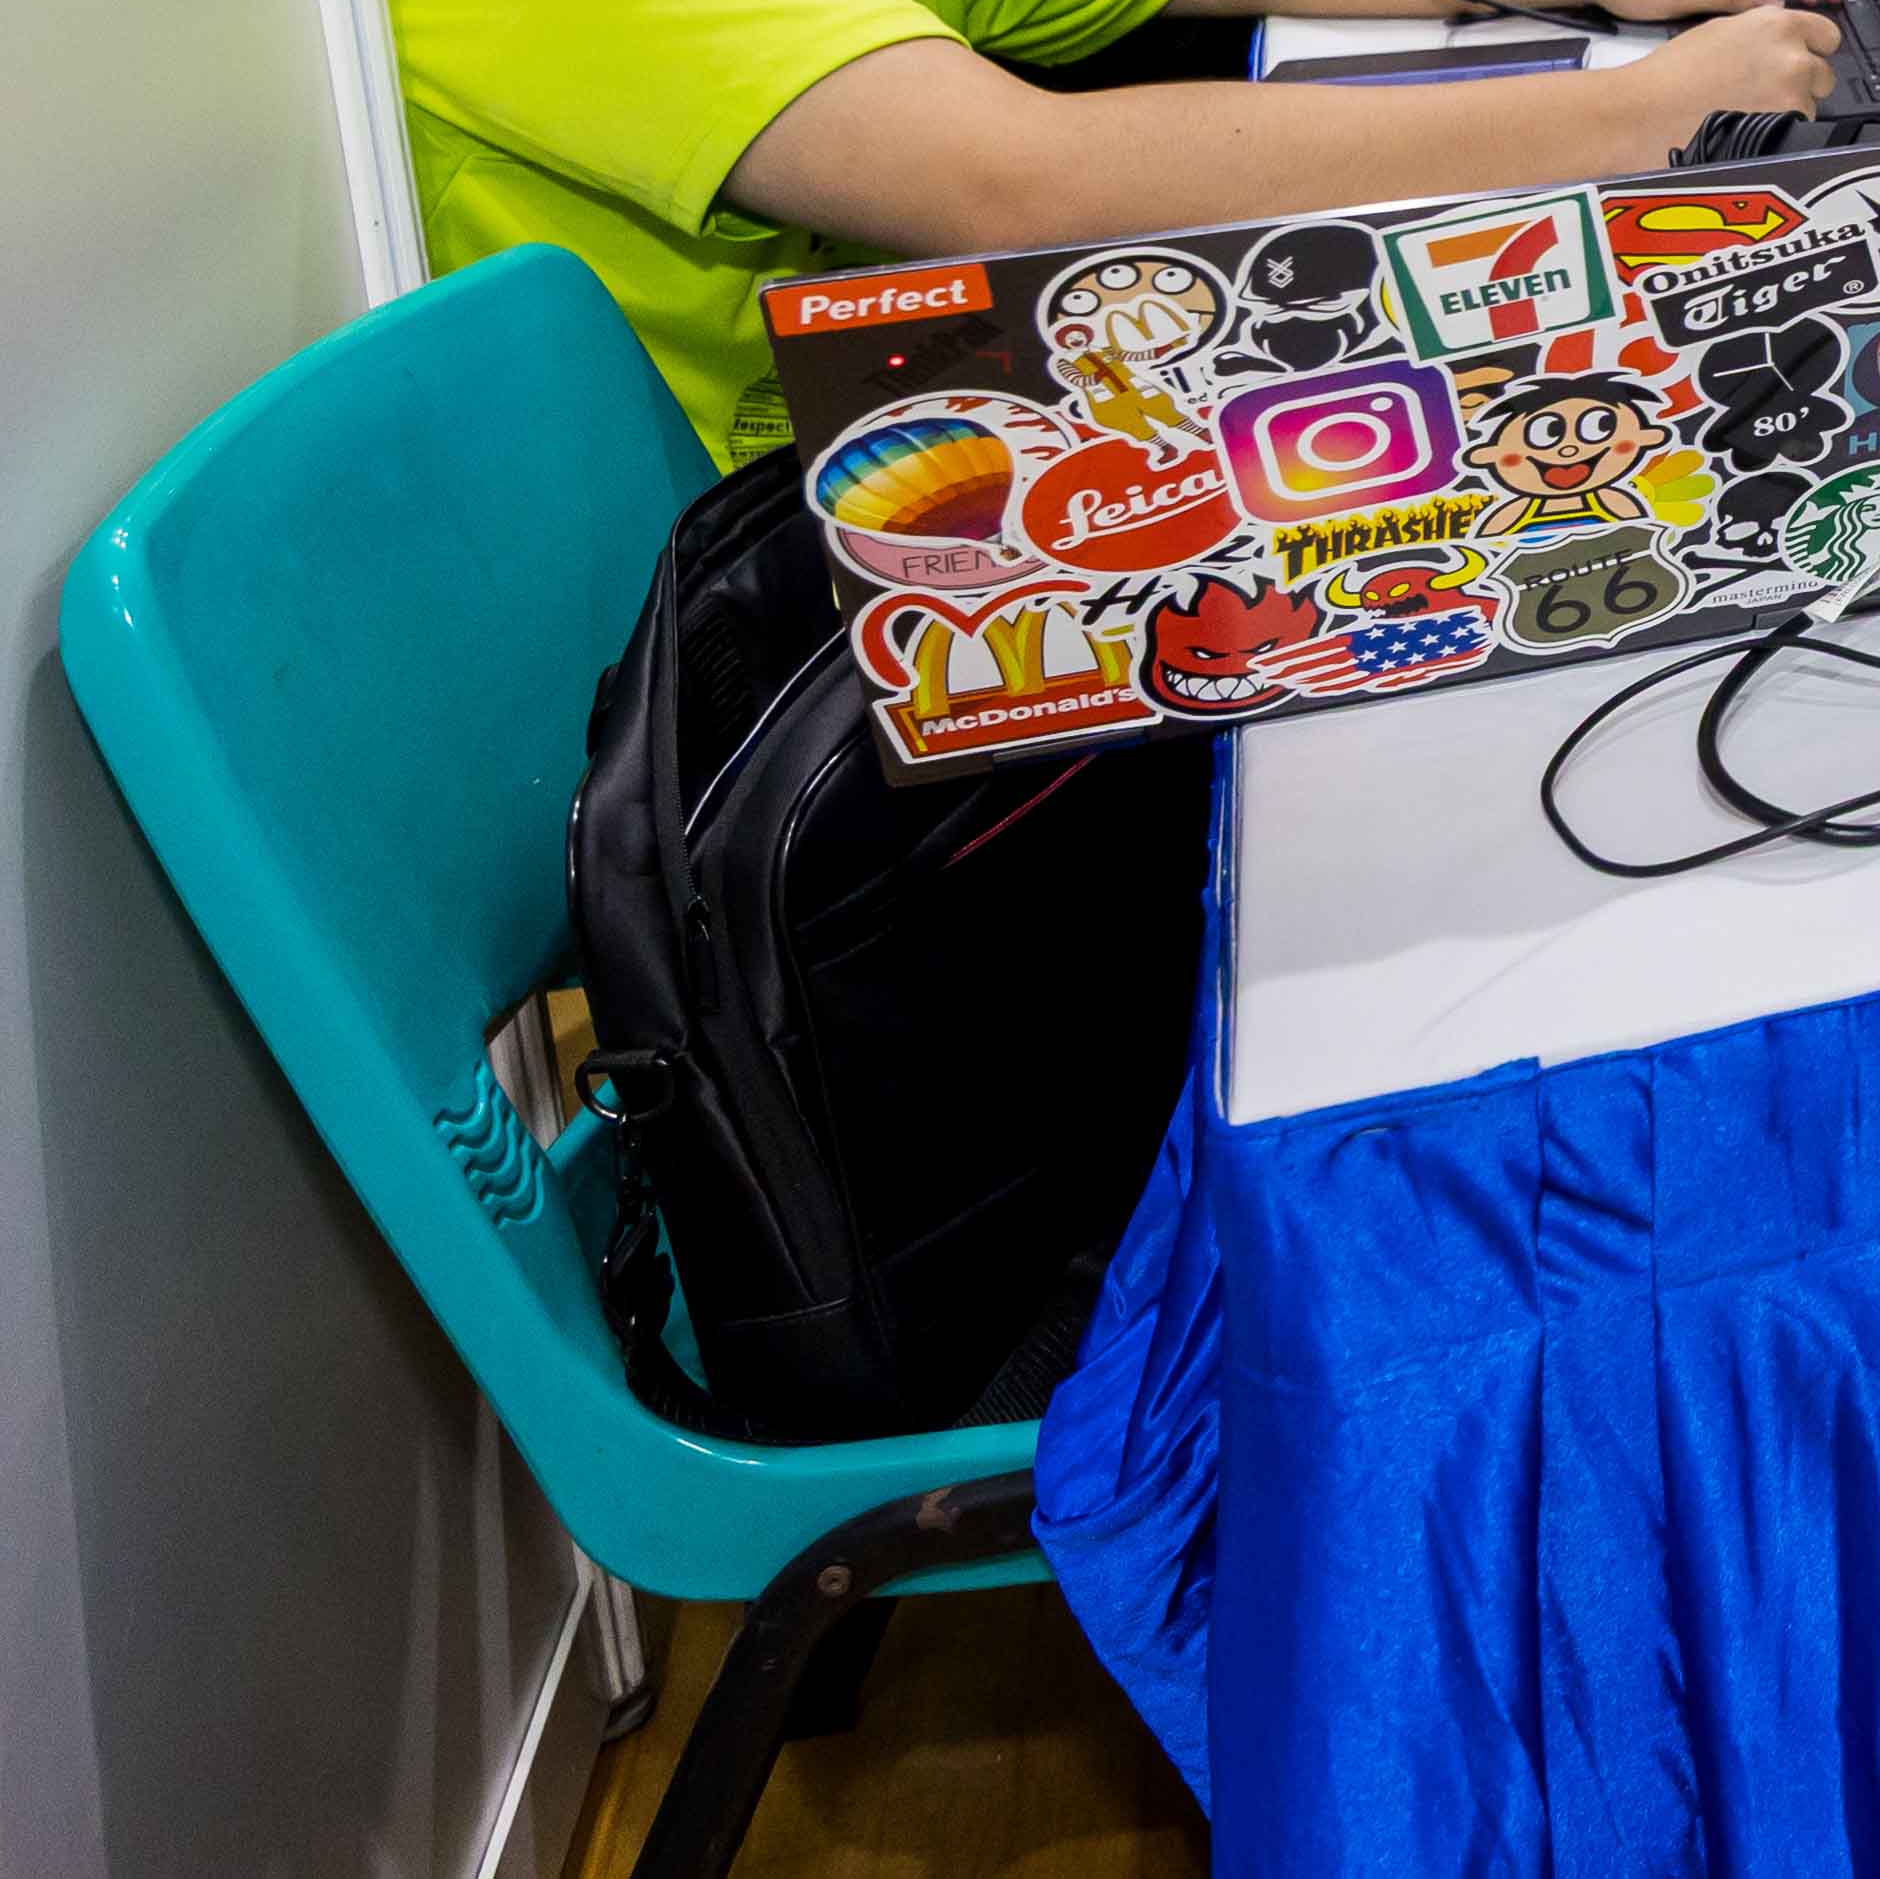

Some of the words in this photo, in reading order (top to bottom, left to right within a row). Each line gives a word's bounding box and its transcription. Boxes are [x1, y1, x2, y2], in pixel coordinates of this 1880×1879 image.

[1426, 216, 1559, 341] 7
[1643, 223, 1866, 294] Onitsuka
[1683, 255, 1847, 331] Tiger
[800, 279, 968, 325] Perfect
[1052, 469, 1228, 551] Leica
[903, 549, 1040, 578] FRIEN
[1523, 548, 1633, 592] ROUTE
[1536, 565, 1658, 634] 66
[922, 687, 1138, 737] McDonald's
